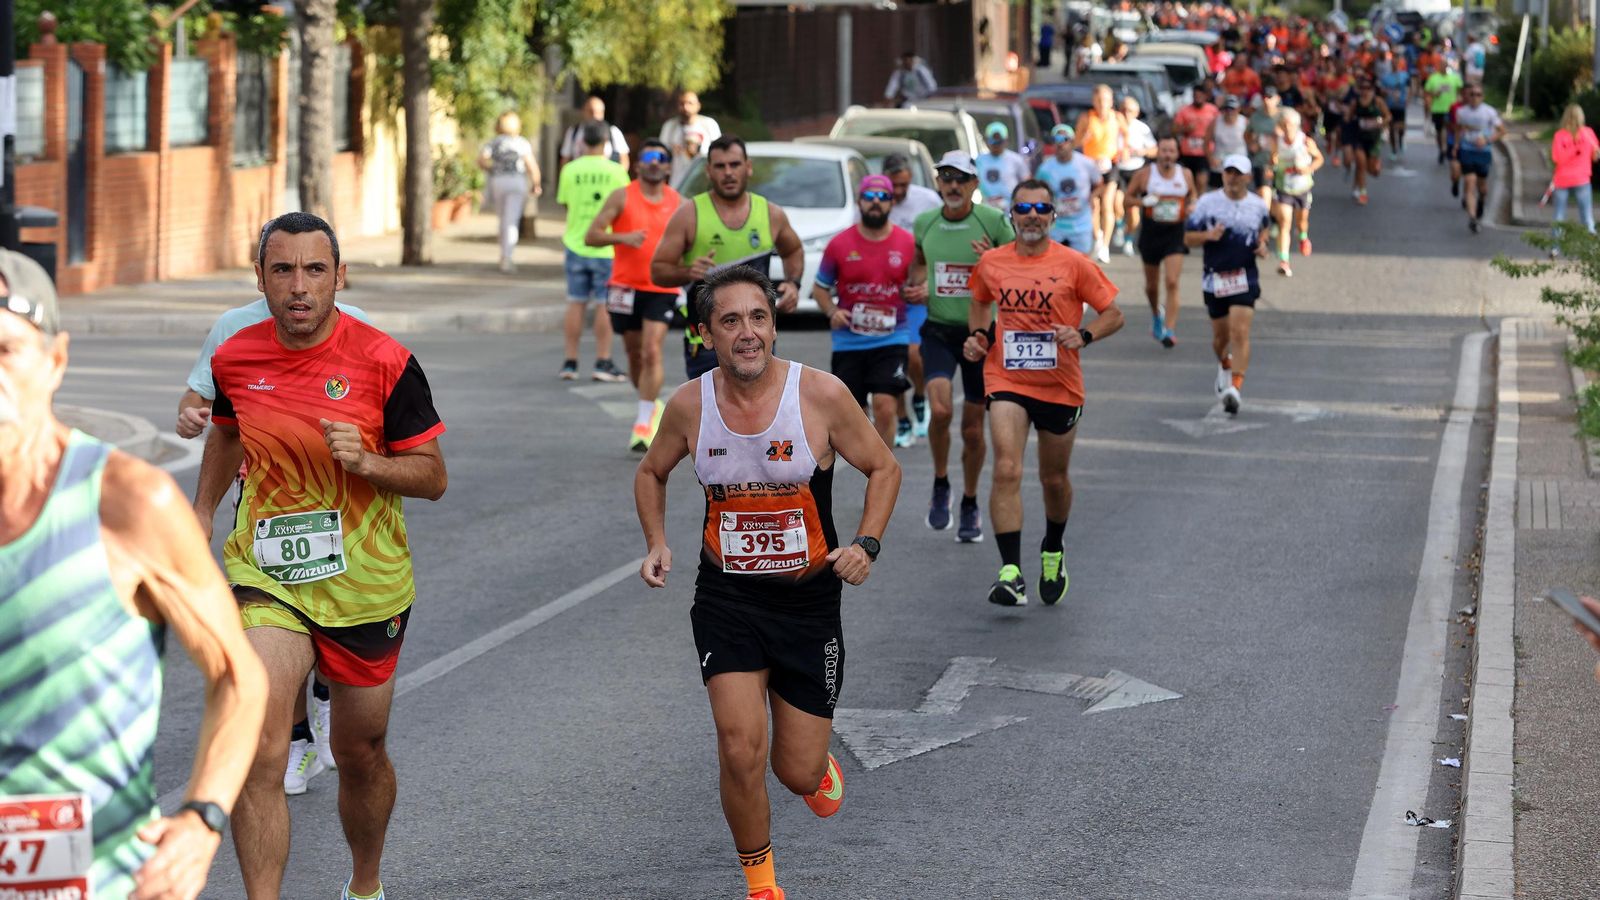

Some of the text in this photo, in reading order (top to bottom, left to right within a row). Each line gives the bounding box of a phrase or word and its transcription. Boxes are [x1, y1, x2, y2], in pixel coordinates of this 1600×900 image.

[1016, 343, 1044, 357] 912
[726, 481, 799, 493] RUBYSAN
[280, 536, 311, 562] 80
[741, 533, 785, 553] 395
[288, 562, 340, 580] MIZUNO
[753, 557, 804, 570] MIZUNO
